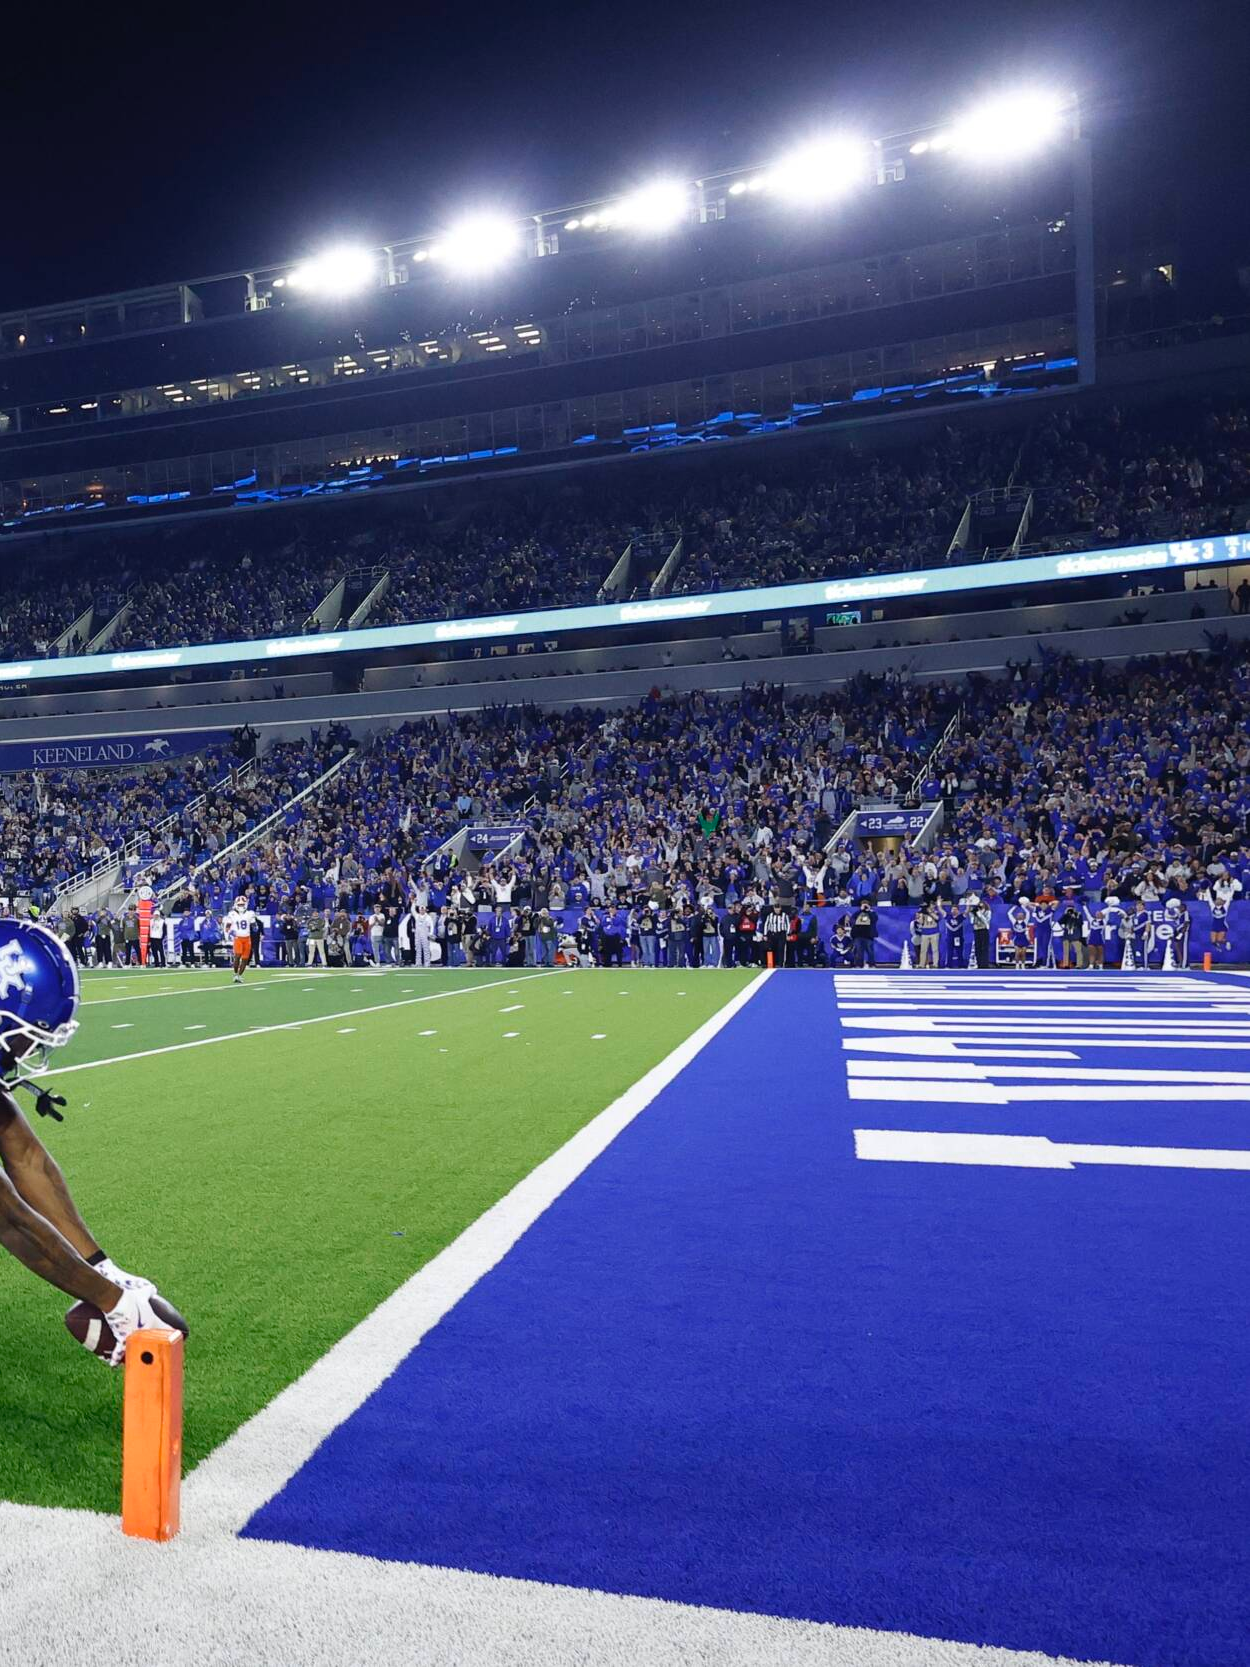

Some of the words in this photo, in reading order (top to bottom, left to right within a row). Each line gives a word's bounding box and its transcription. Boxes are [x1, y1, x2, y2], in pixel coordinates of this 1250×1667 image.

[1202, 542, 1214, 560] 3
[1057, 550, 1167, 575] ticketmaste
[32, 743, 134, 765] KEENELAND
[868, 817, 882, 830] 23
[909, 815, 924, 828] 22
[476, 833, 489, 844] 24
[236, 919, 248, 930] 18
